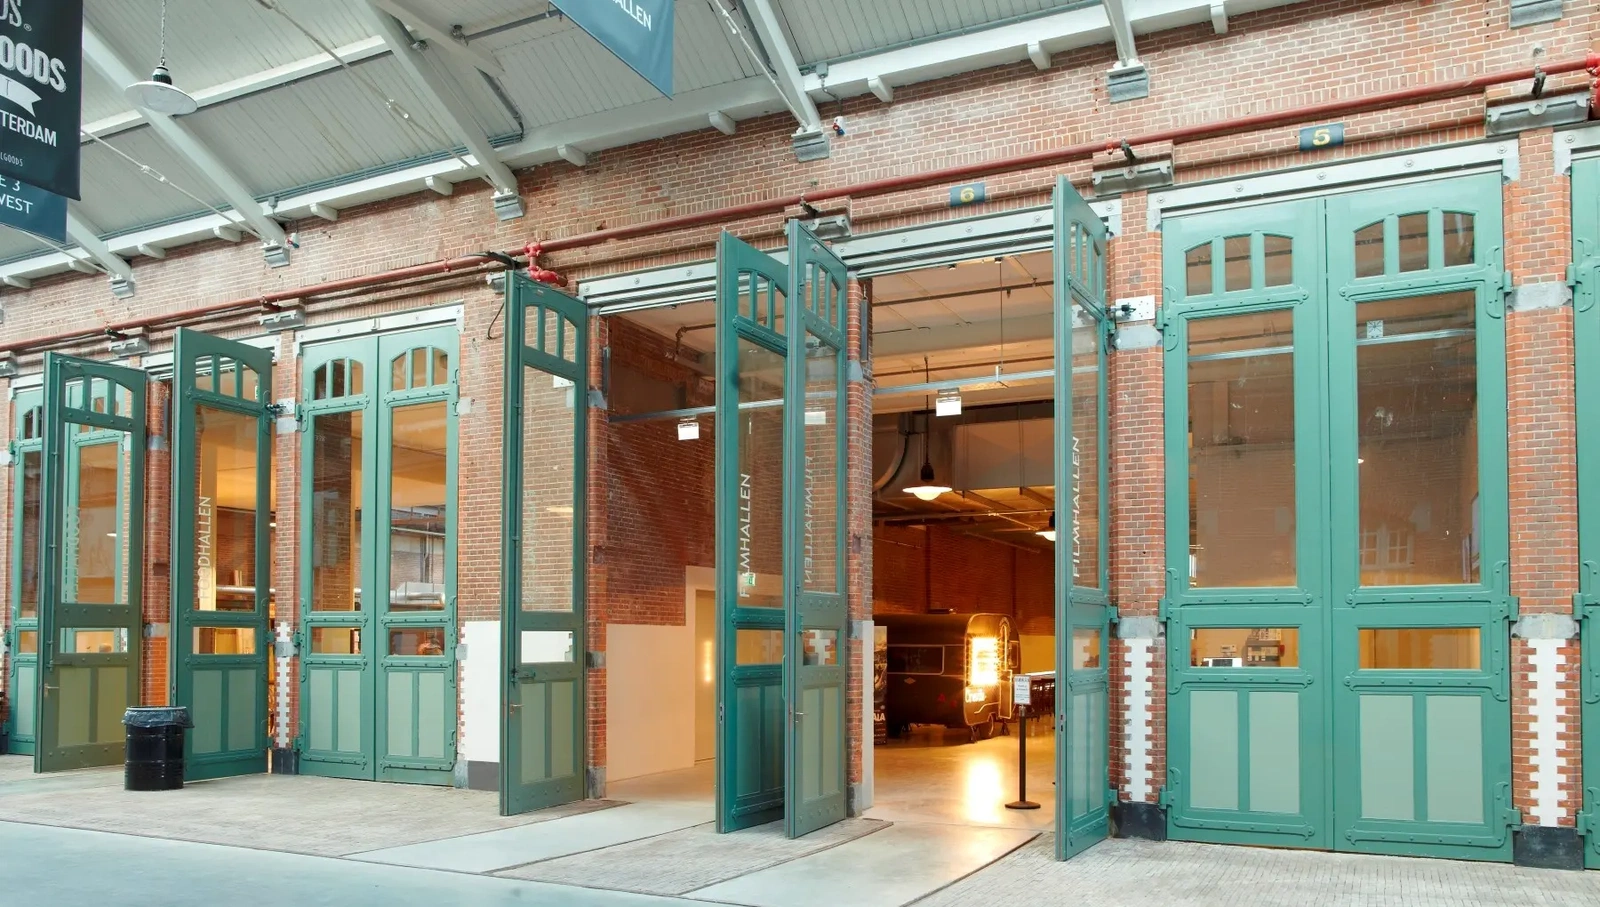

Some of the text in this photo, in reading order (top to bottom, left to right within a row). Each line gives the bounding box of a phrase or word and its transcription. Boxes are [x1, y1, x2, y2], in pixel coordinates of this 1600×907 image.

[0, 109, 56, 147] TERDAM
[1312, 128, 1331, 147] 5
[12, 180, 21, 191] 3
[960, 187, 975, 203] 6
[1072, 436, 1081, 578] FILMHALLEN
